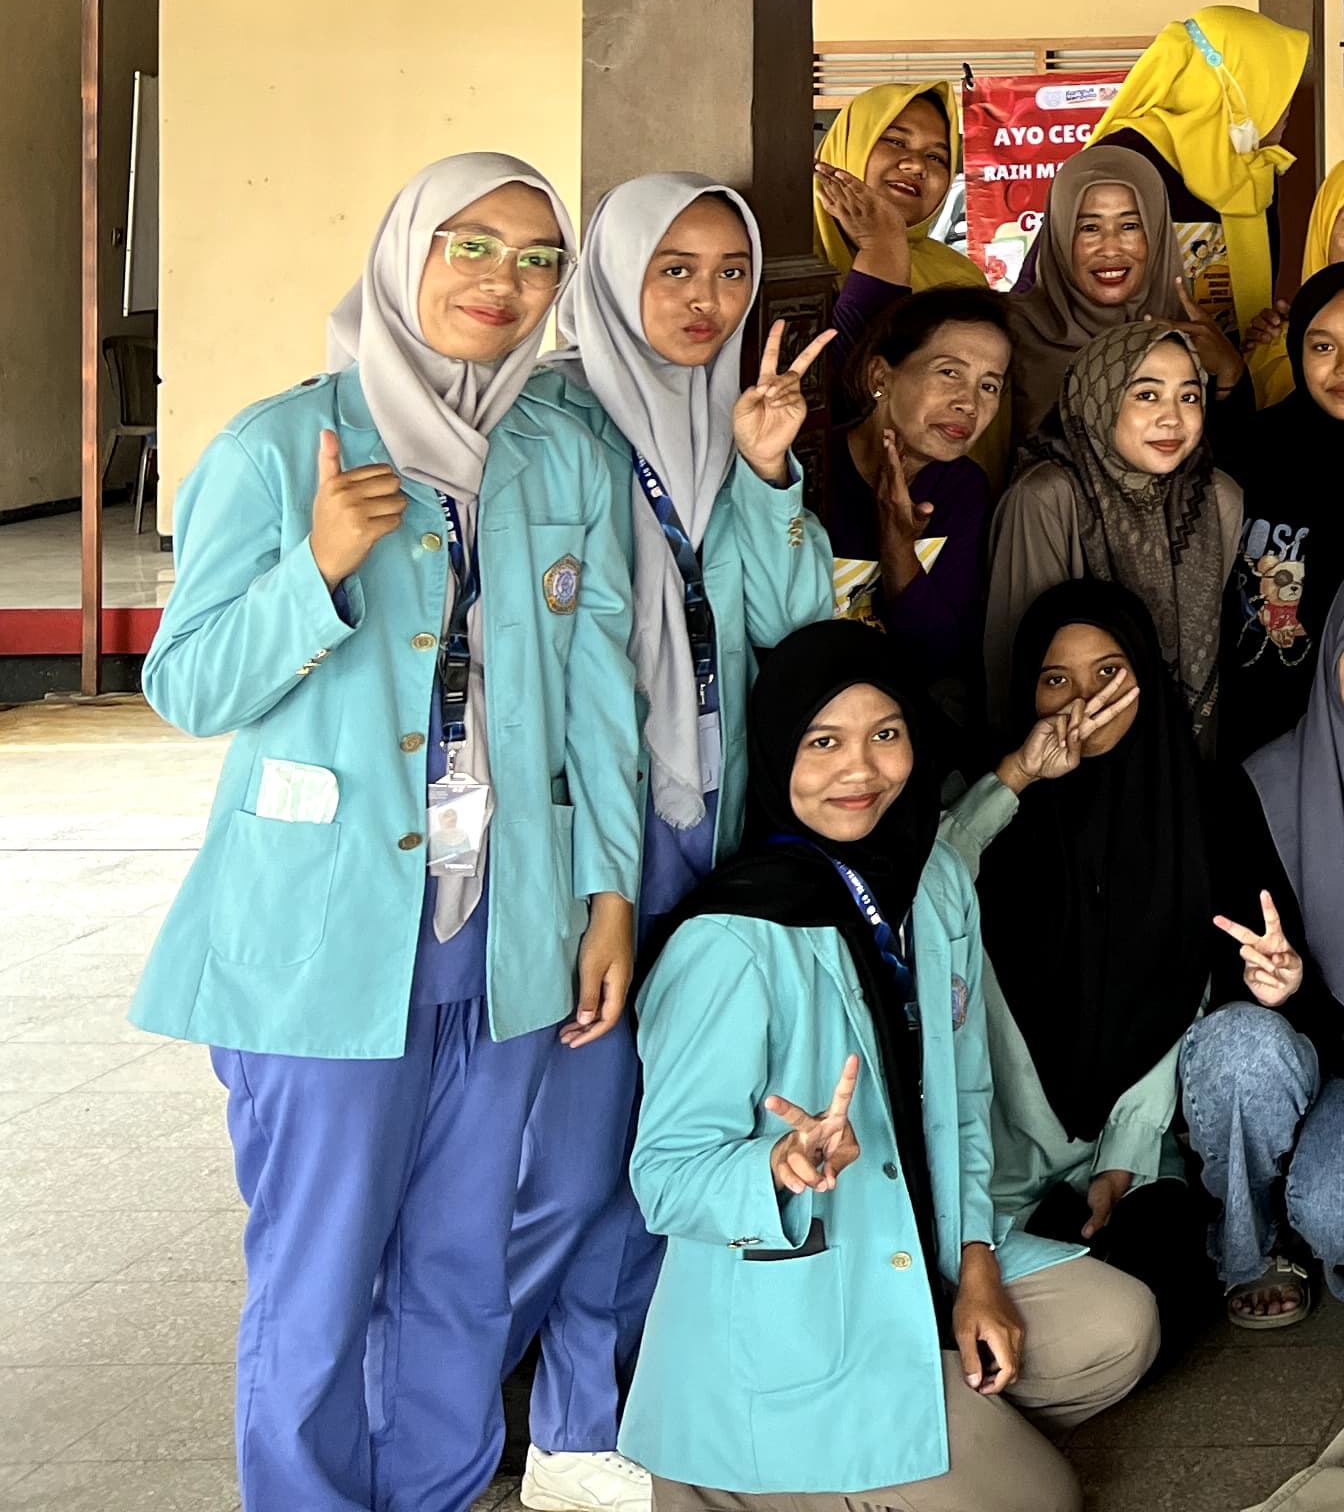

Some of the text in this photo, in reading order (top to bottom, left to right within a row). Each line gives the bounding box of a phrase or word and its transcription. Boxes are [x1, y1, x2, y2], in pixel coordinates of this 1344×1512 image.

[993, 124, 1098, 147] AYO CEG
[983, 162, 1064, 182] RAIH M
